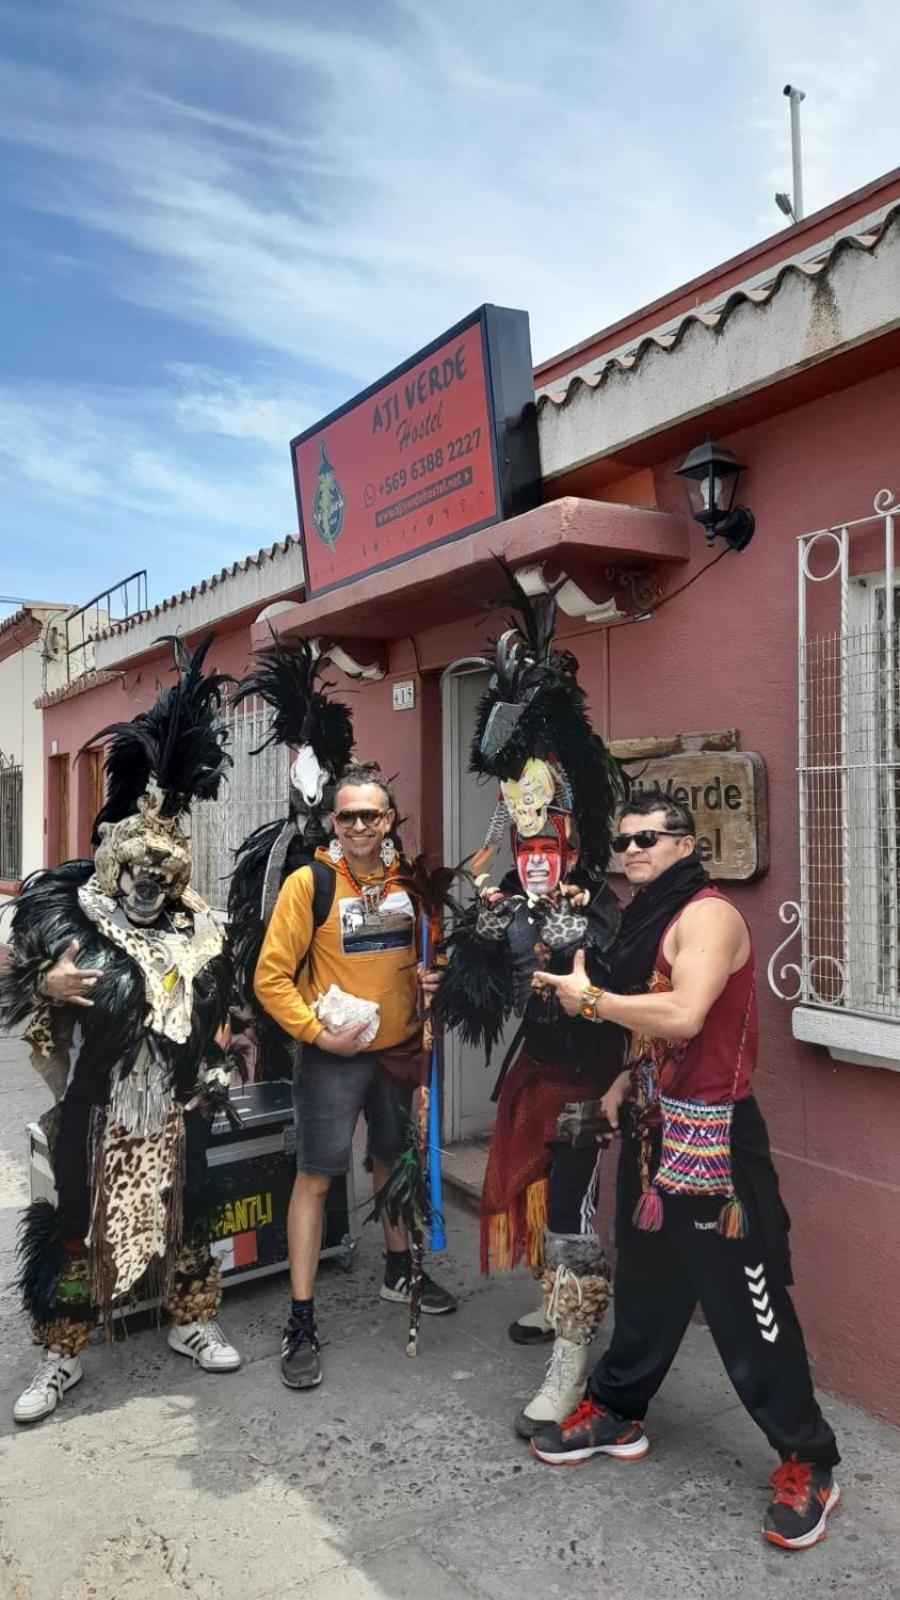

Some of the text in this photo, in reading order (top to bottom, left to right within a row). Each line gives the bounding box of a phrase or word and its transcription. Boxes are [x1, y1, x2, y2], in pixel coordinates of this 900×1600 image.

[373, 344, 467, 434] AJI VERDE
[396, 400, 442, 451] Hostel
[378, 427, 481, 495] +569 6388 2227
